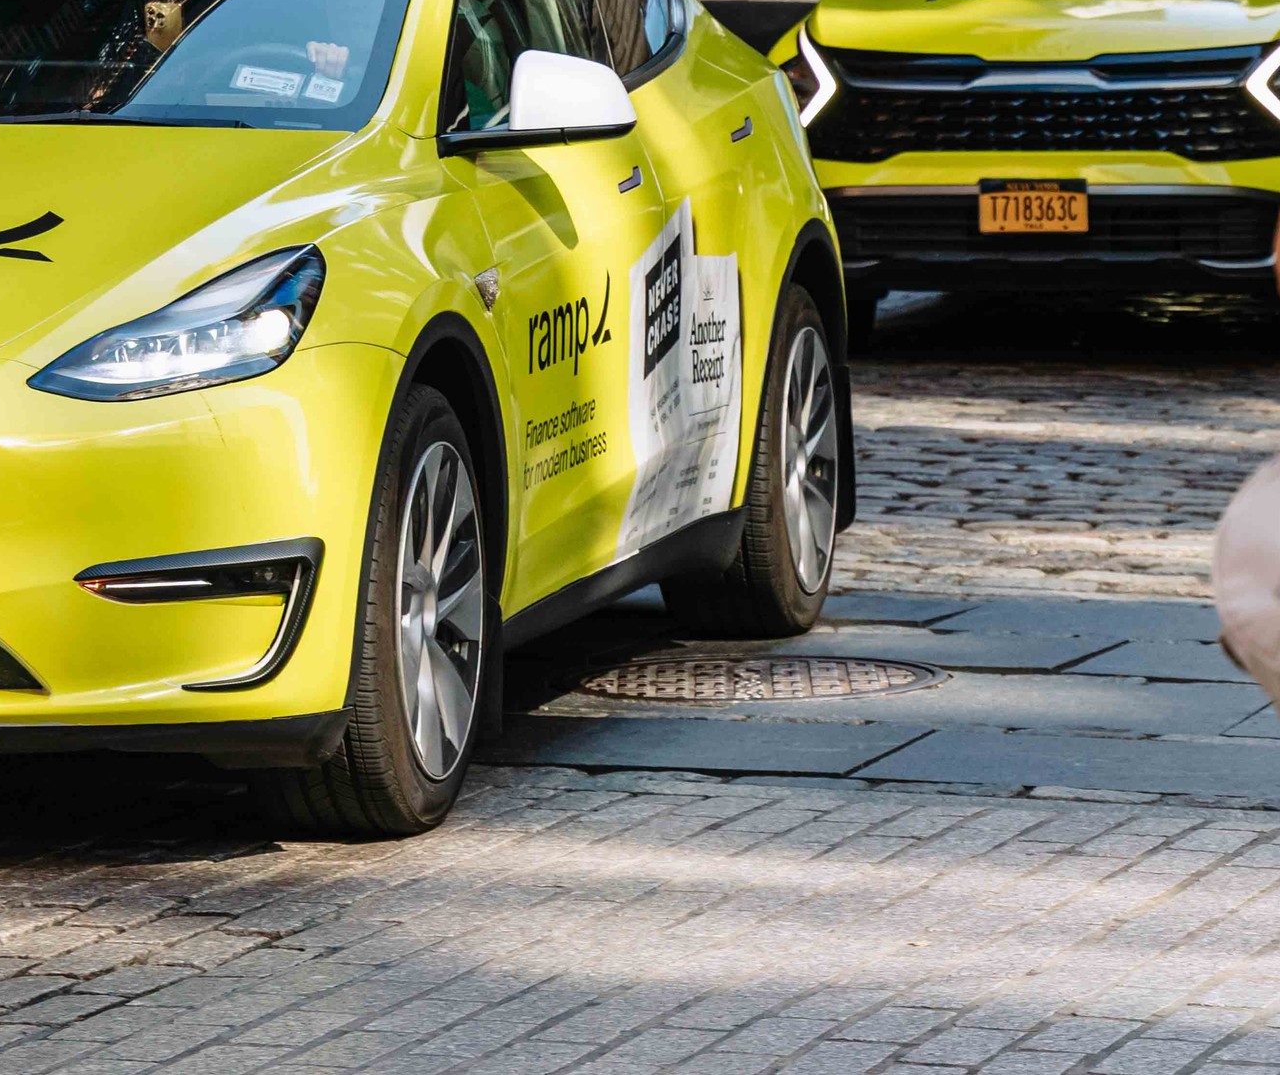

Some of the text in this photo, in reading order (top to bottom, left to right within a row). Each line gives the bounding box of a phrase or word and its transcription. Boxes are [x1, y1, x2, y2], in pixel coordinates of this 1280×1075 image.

[990, 196, 1078, 222] T718363C
[648, 259, 678, 316] NEVER
[528, 297, 589, 376] ramp
[647, 295, 680, 356] CHASE
[690, 311, 726, 345] Another
[692, 349, 725, 388] Receipt
[525, 398, 596, 452] Finance software
[523, 432, 607, 492] for modern business
